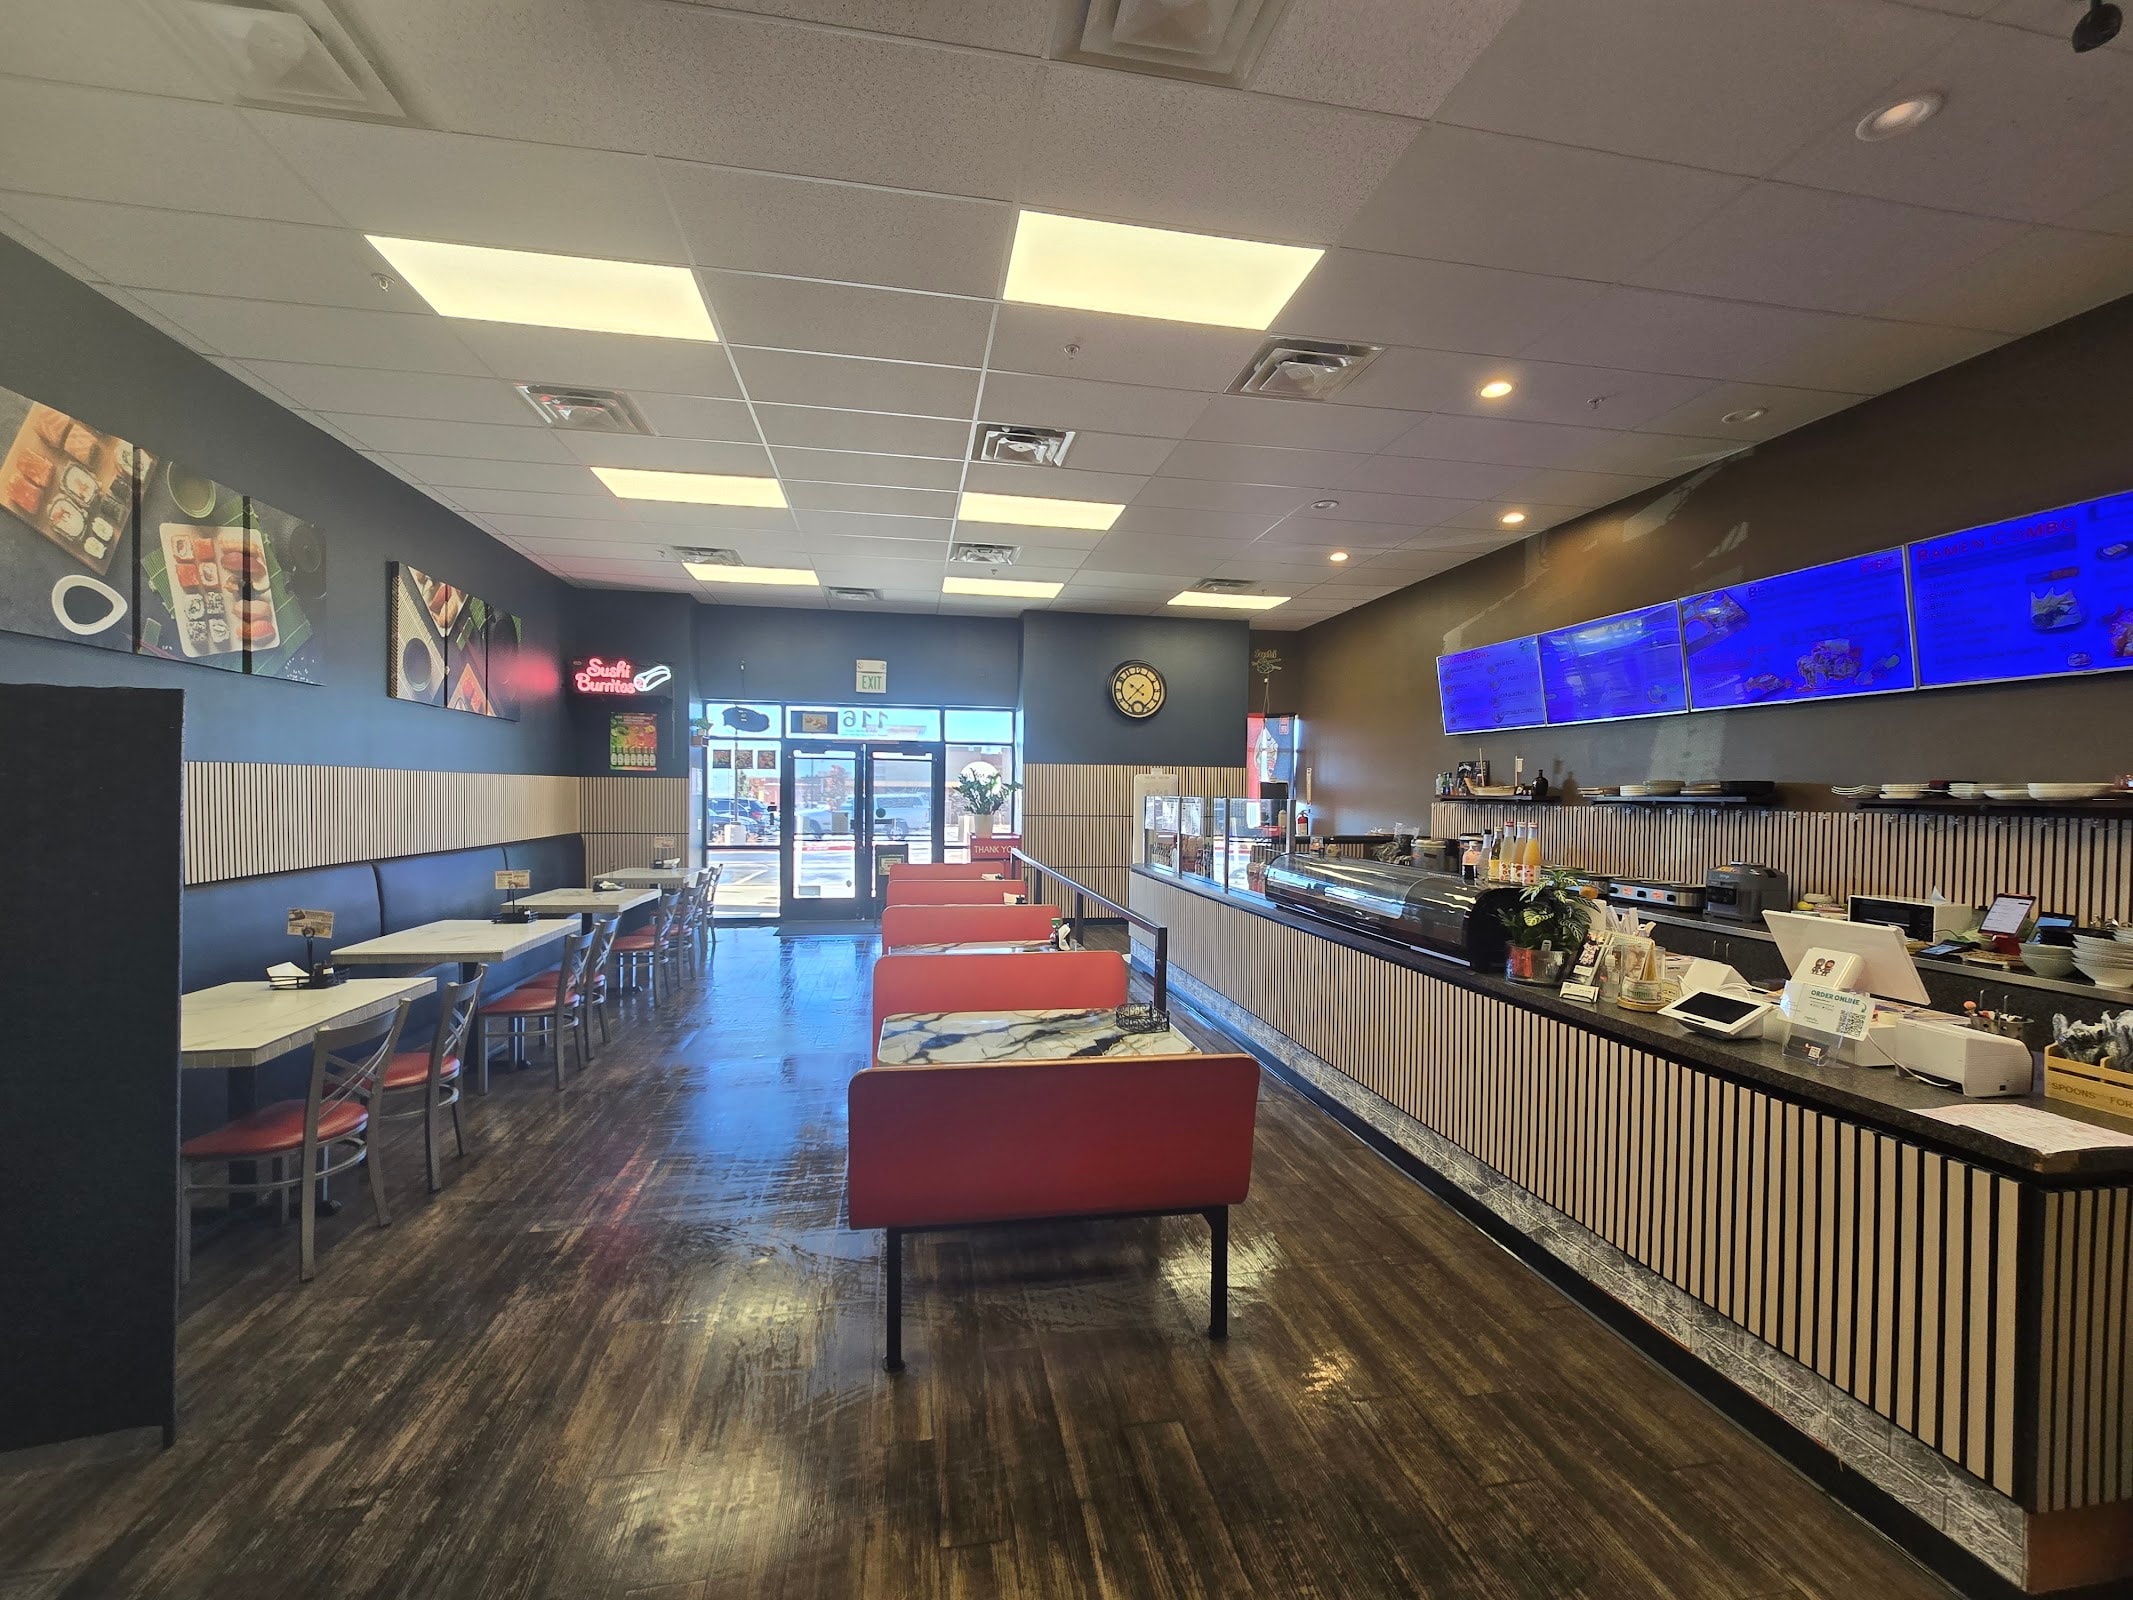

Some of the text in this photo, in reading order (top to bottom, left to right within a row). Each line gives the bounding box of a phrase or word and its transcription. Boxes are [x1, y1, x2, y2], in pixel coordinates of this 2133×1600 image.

[1917, 518, 2076, 562] RAMEN COMBO
[586, 658, 631, 679] Sushi
[575, 672, 635, 694] Burritos
[862, 675, 882, 690] EXIT
[974, 845, 999, 854] THANK
[1810, 990, 1833, 1000] ORDER
[1834, 995, 1861, 1006] ONLINE
[2051, 1082, 2096, 1099] SPOONS
